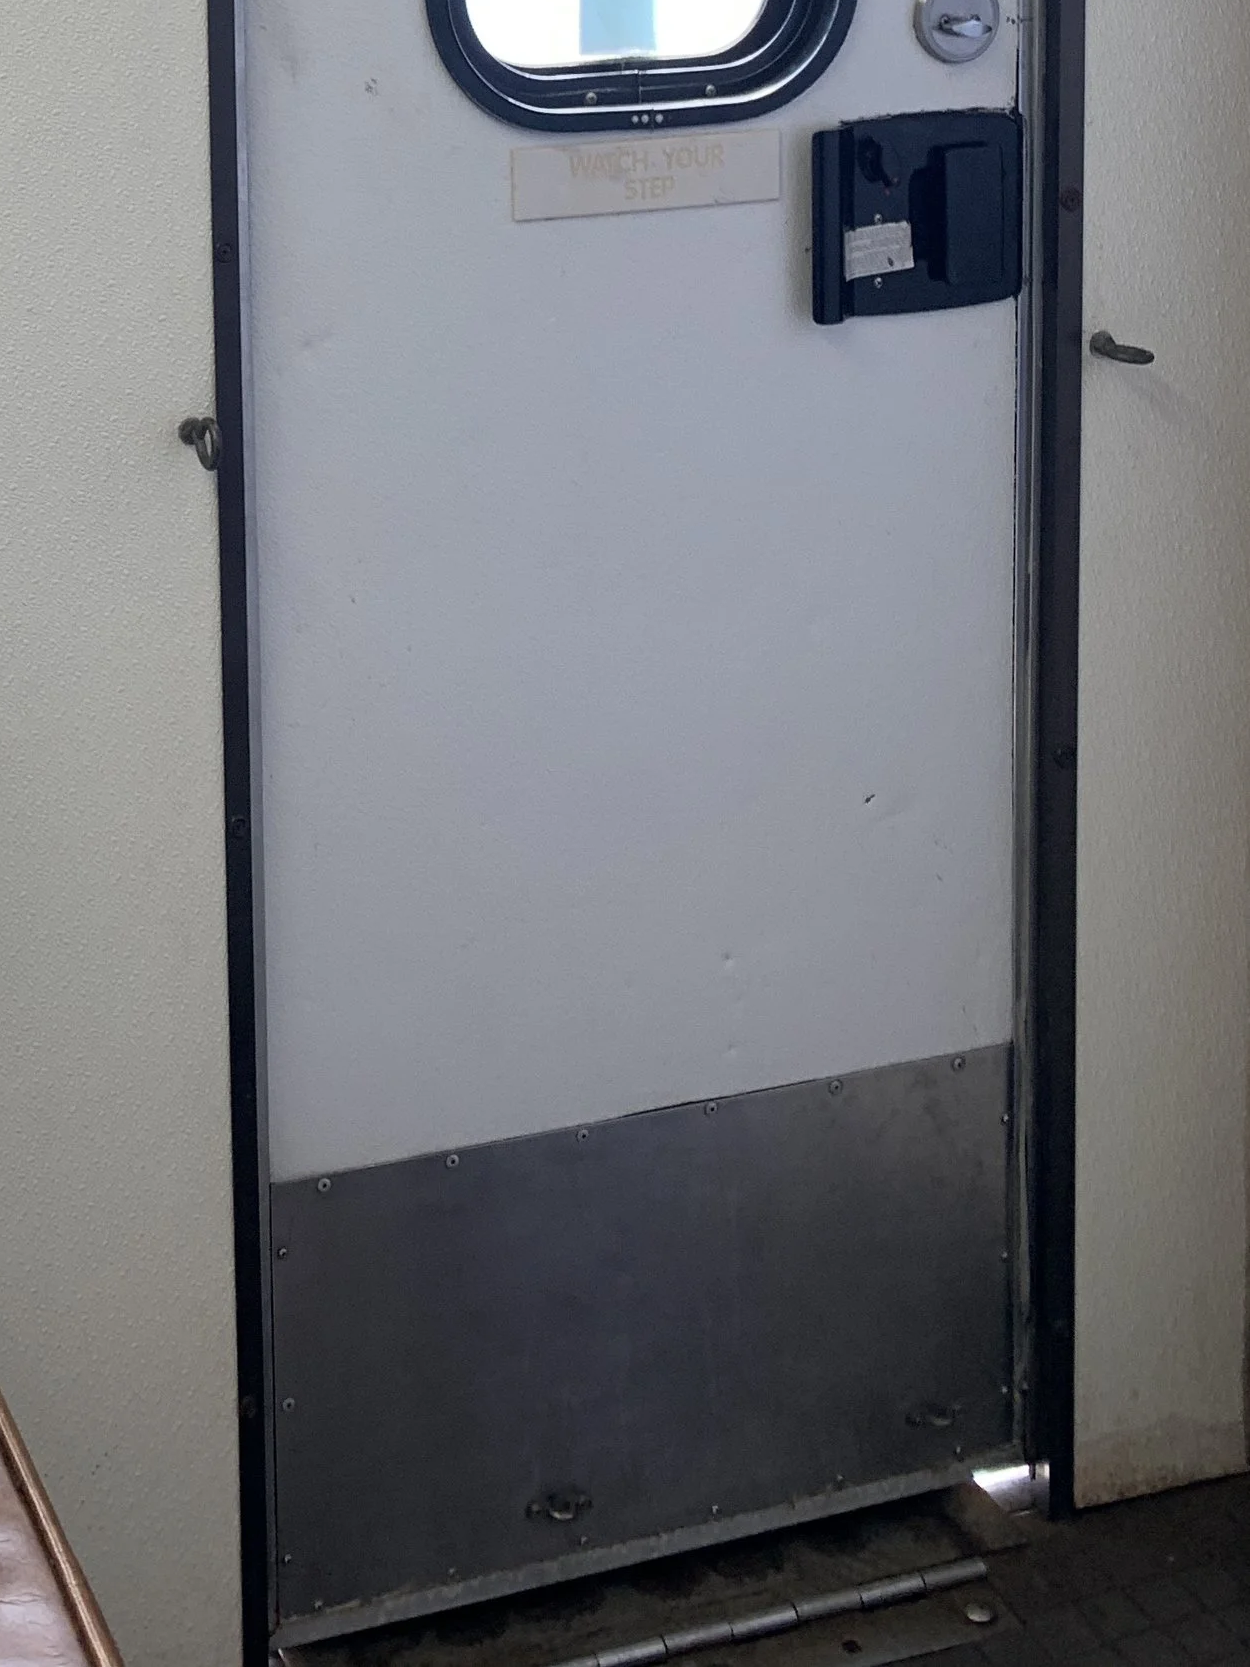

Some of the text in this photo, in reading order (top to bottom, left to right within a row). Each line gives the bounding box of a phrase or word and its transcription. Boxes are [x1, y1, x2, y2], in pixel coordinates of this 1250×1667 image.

[568, 143, 725, 178] WATCH YOUR
[623, 174, 676, 201] STEP
